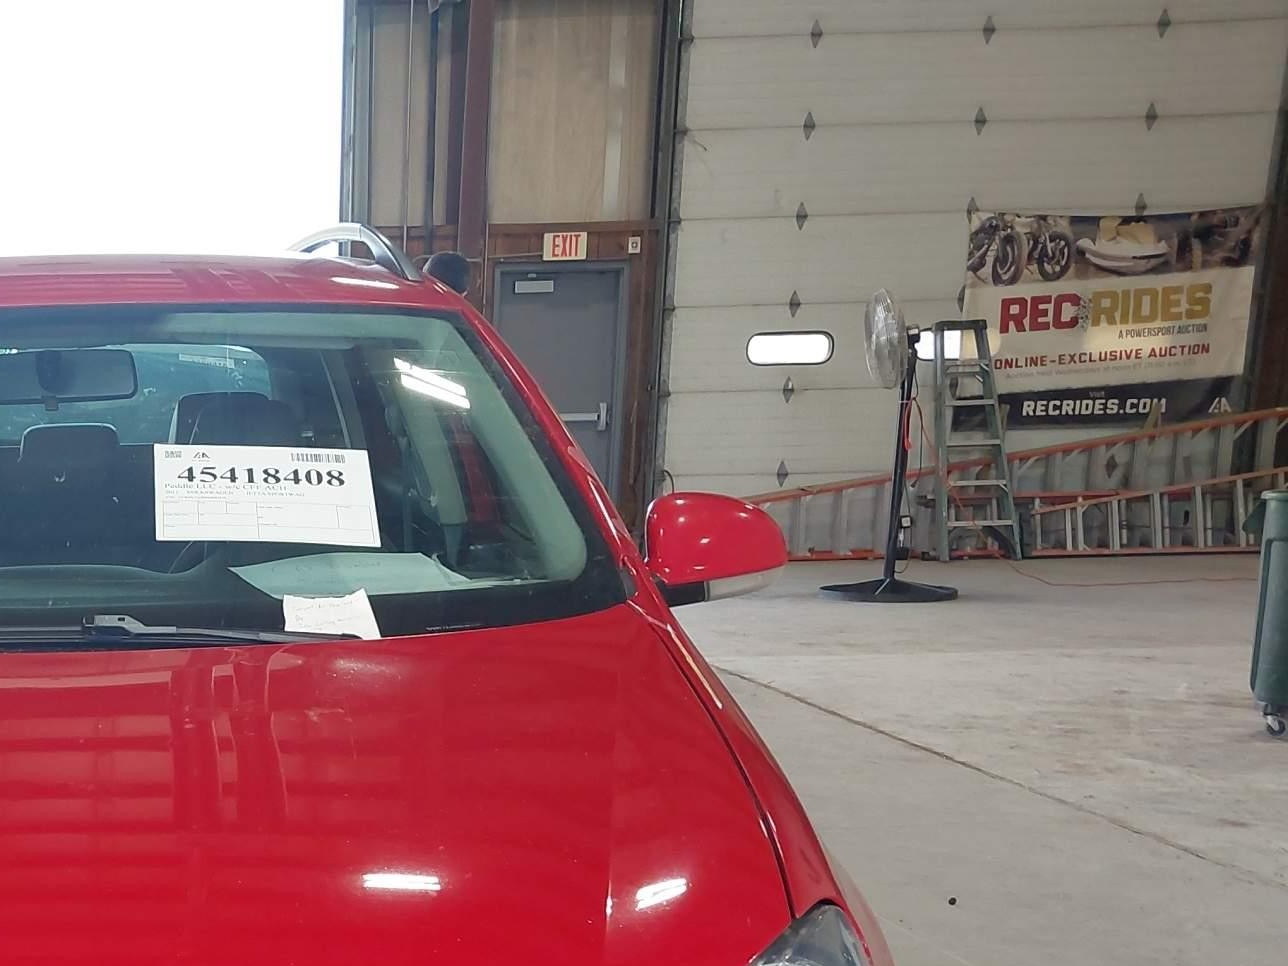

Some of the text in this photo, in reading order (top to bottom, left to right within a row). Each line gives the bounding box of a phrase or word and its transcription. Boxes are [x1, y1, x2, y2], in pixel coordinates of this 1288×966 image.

[551, 233, 581, 257] EXIT
[999, 283, 1212, 334] REC RIDES
[1118, 322, 1208, 339] A POWERSPORT AUCTION
[994, 348, 1143, 370] ONLINE-EXCLUSIVE
[1147, 343, 1210, 359] AUCTION
[177, 465, 346, 487] 45418408
